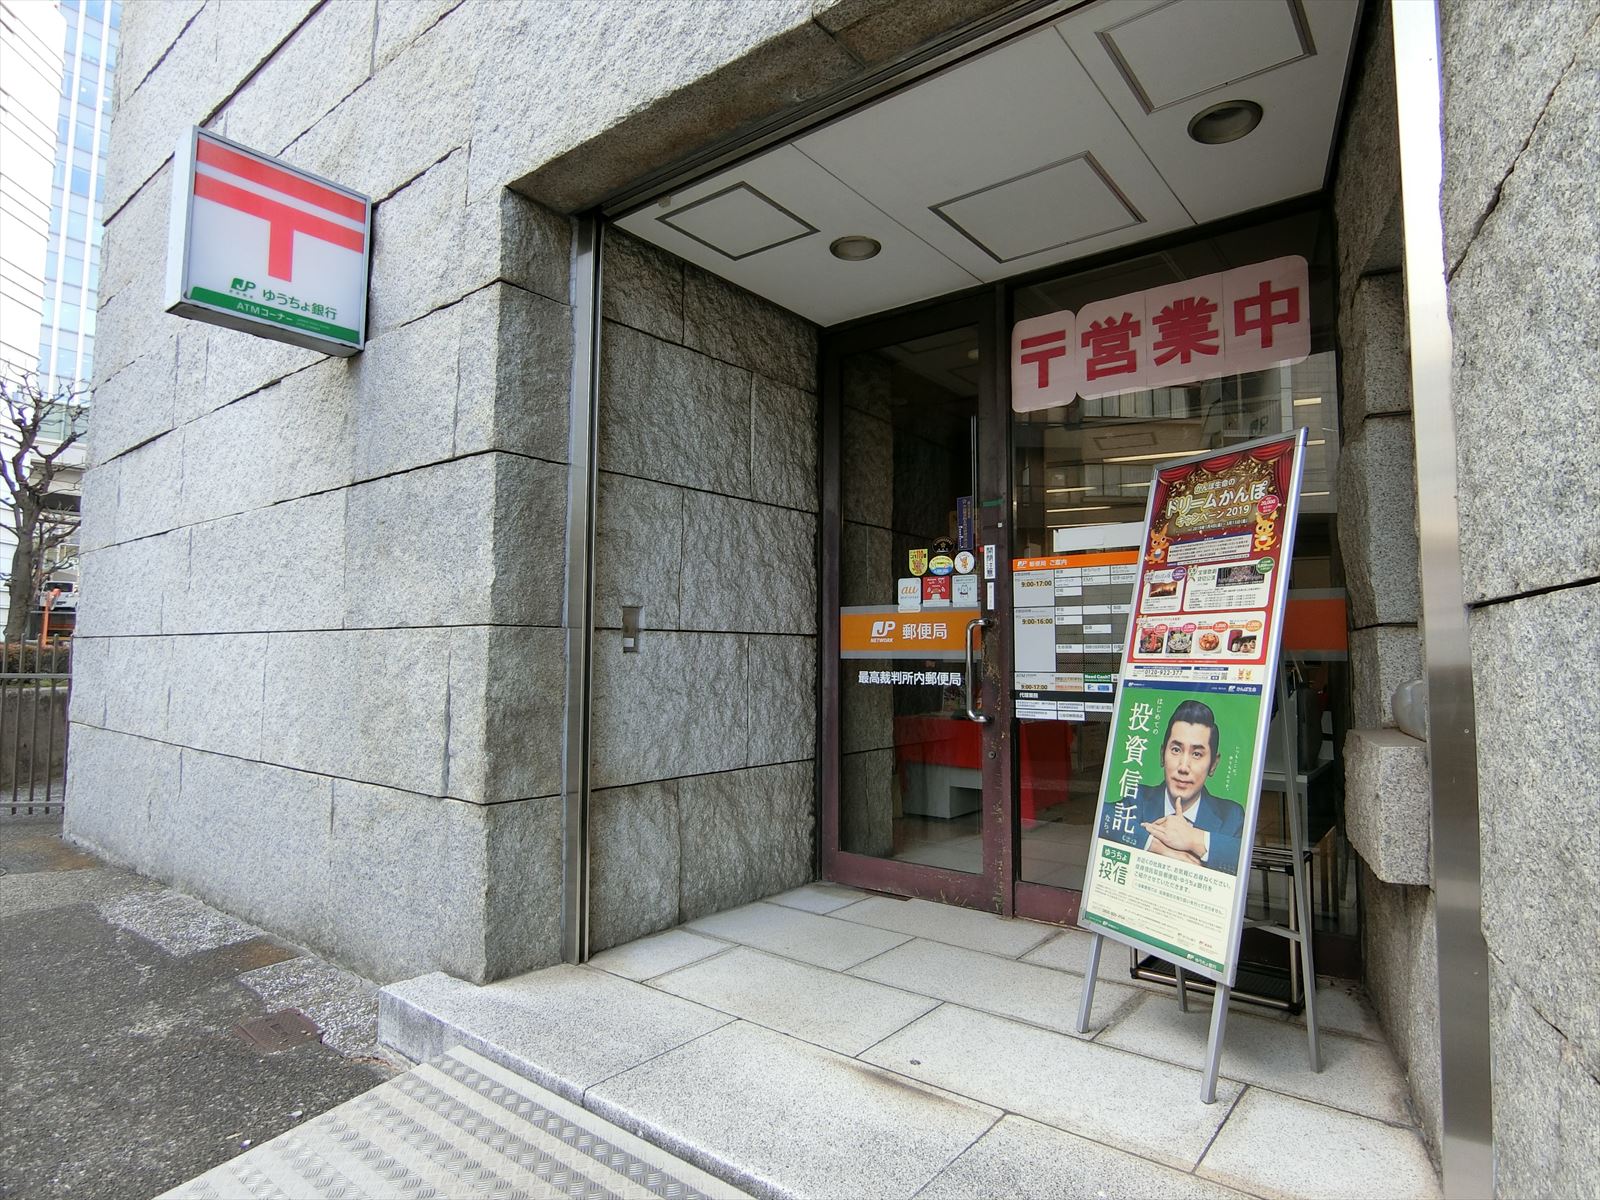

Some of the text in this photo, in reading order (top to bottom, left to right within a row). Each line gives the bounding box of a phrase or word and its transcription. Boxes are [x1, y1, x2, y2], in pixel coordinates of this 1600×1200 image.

[236, 302, 293, 322] ATMコーナー
[263, 289, 337, 320] ゆうちょ銀行
[1081, 280, 1300, 382] 営業中
[1167, 480, 1269, 517] ドリームかんぽ
[1175, 504, 1250, 527] キャンペーン 2019
[1021, 580, 1053, 588] 9:00-17:00
[902, 623, 948, 640] 郵便局
[858, 670, 962, 687] 最高裁判所内郵便局
[1152, 698, 1163, 735] はじめての
[1111, 702, 1153, 834] 投資信託
[1104, 848, 1128, 861] ゆうちょ
[1098, 860, 1128, 886] 投信
